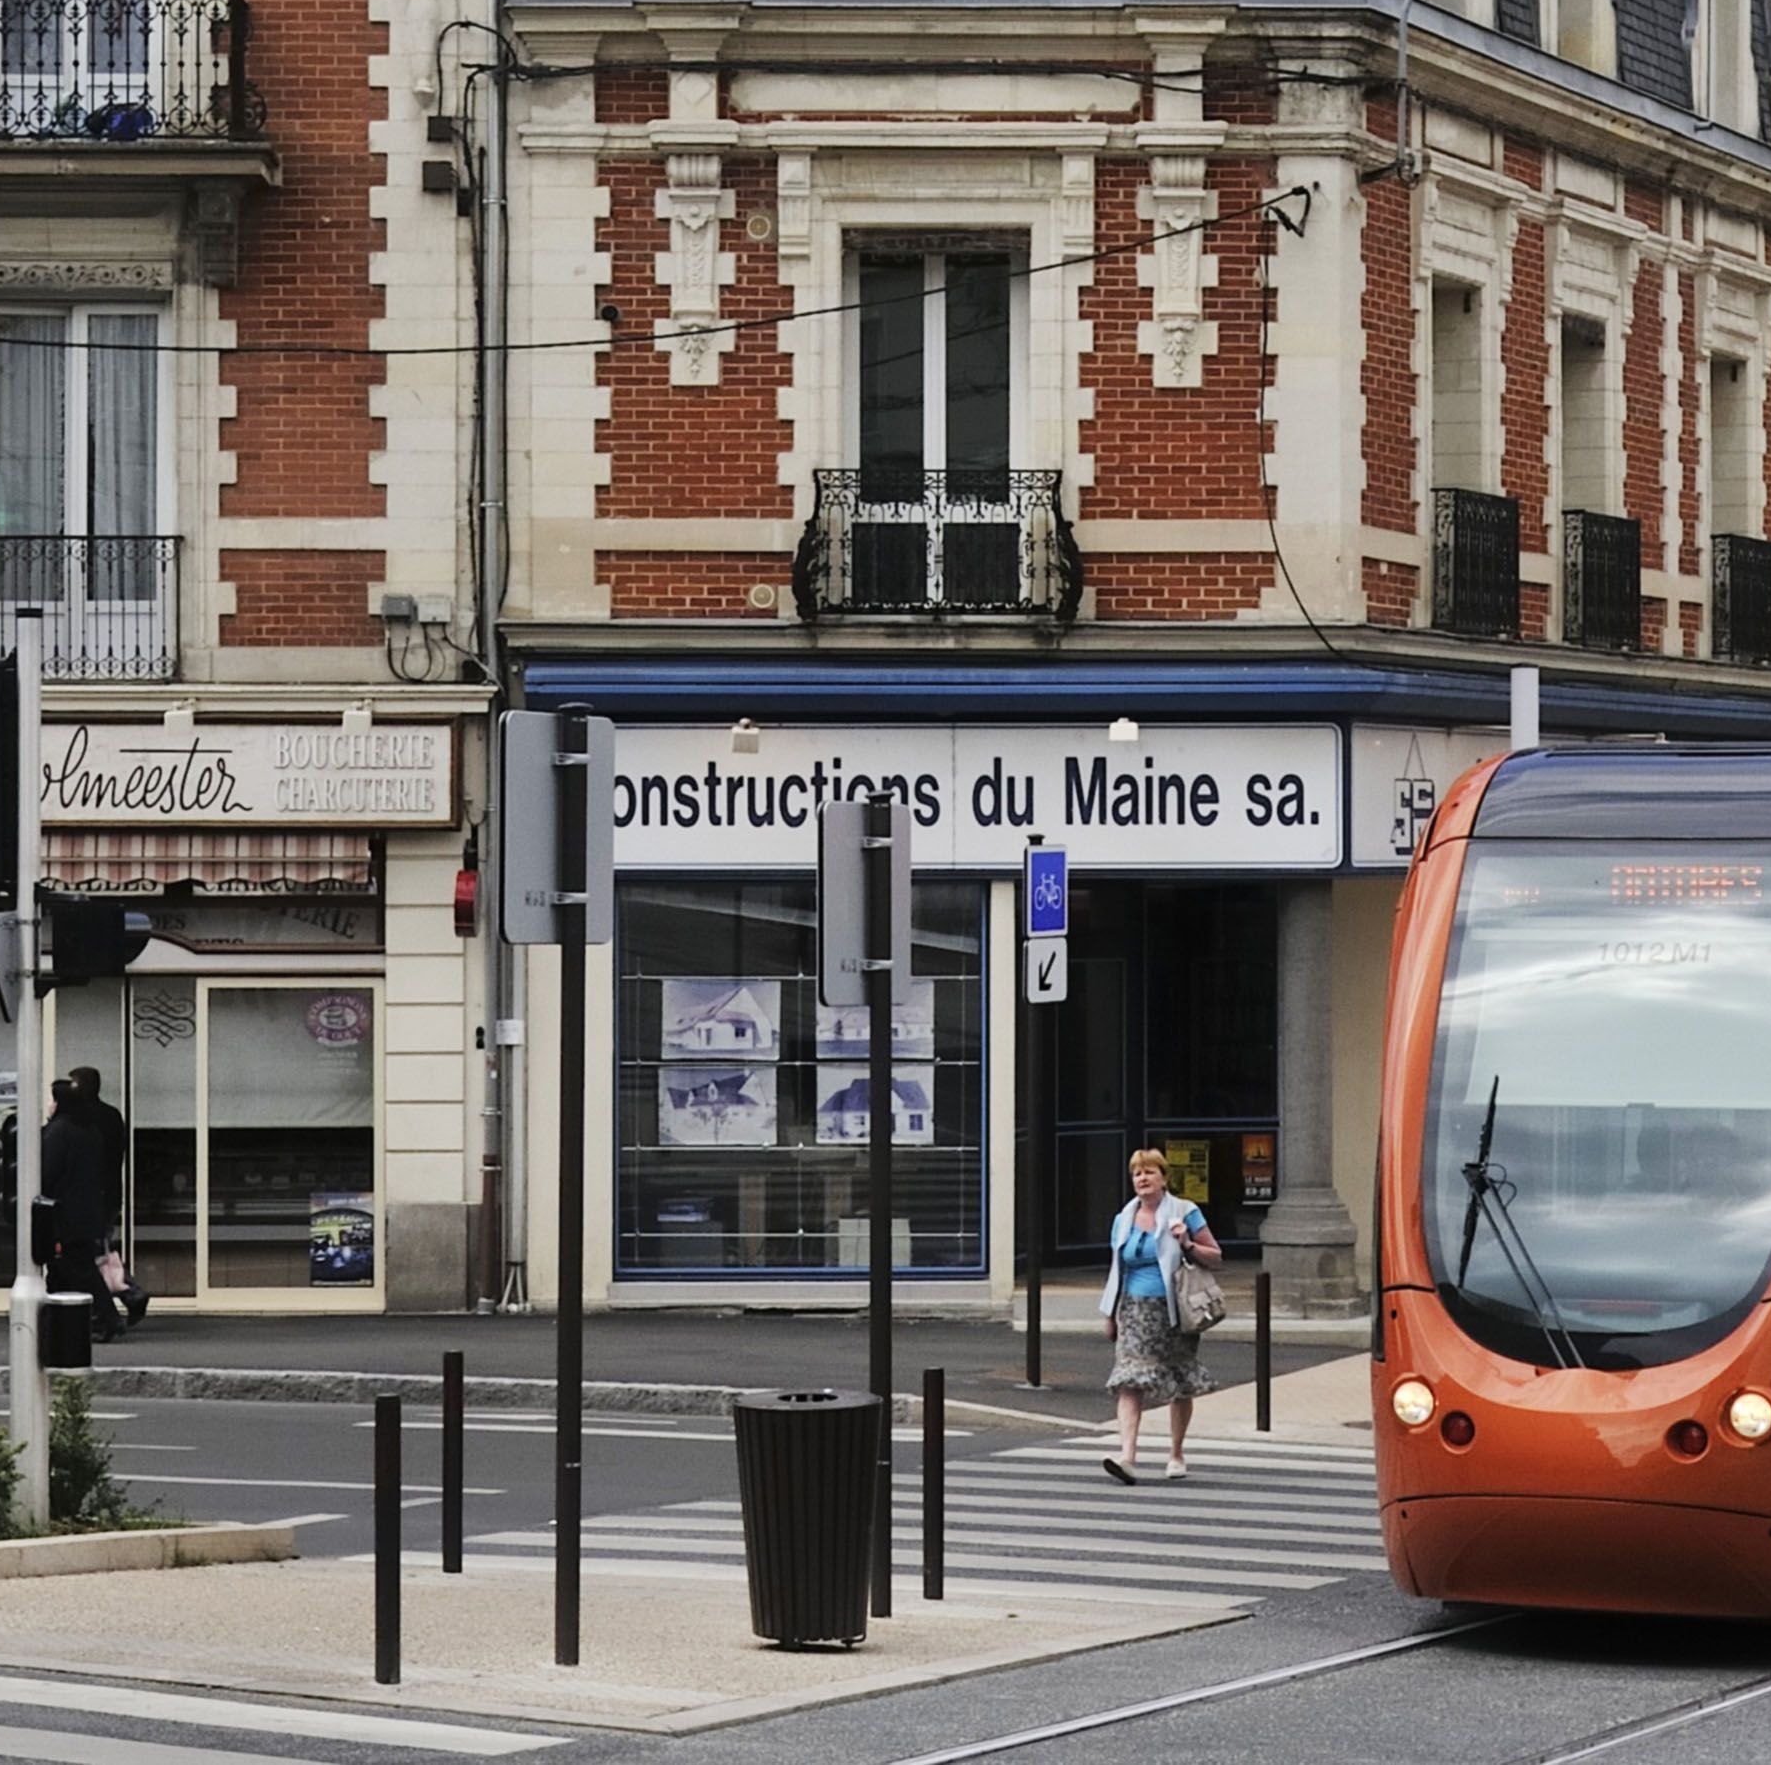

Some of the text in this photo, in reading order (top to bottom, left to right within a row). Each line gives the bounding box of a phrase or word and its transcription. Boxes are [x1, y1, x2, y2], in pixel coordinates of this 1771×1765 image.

[274, 734, 435, 770] BOUCHERIE
[274, 777, 436, 813] CHARCUTERIE
[614, 756, 1320, 828] onstructions du Maine sa.
